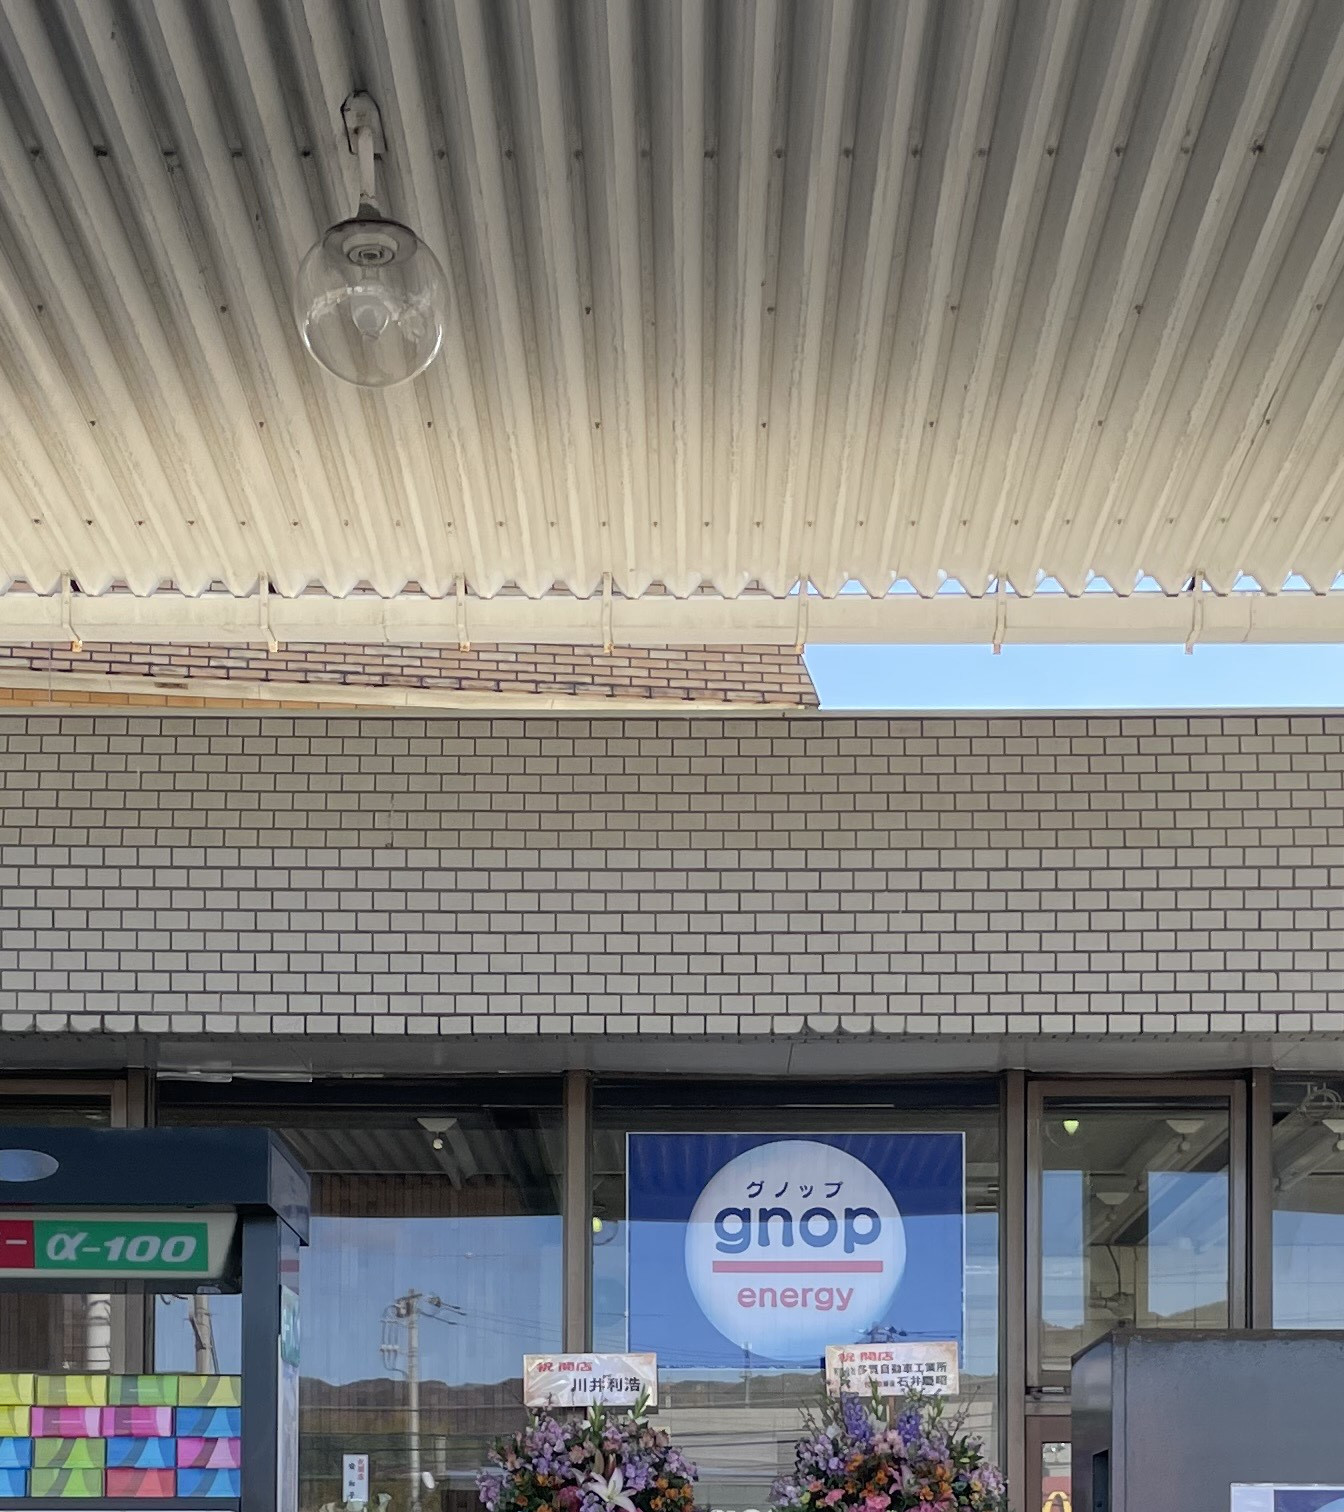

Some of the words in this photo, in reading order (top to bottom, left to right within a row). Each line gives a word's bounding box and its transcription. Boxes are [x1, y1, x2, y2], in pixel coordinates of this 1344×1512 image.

[746, 1180, 844, 1199] グノップ
[712, 1203, 882, 1255] gnop
[736, 1282, 855, 1311] energy
